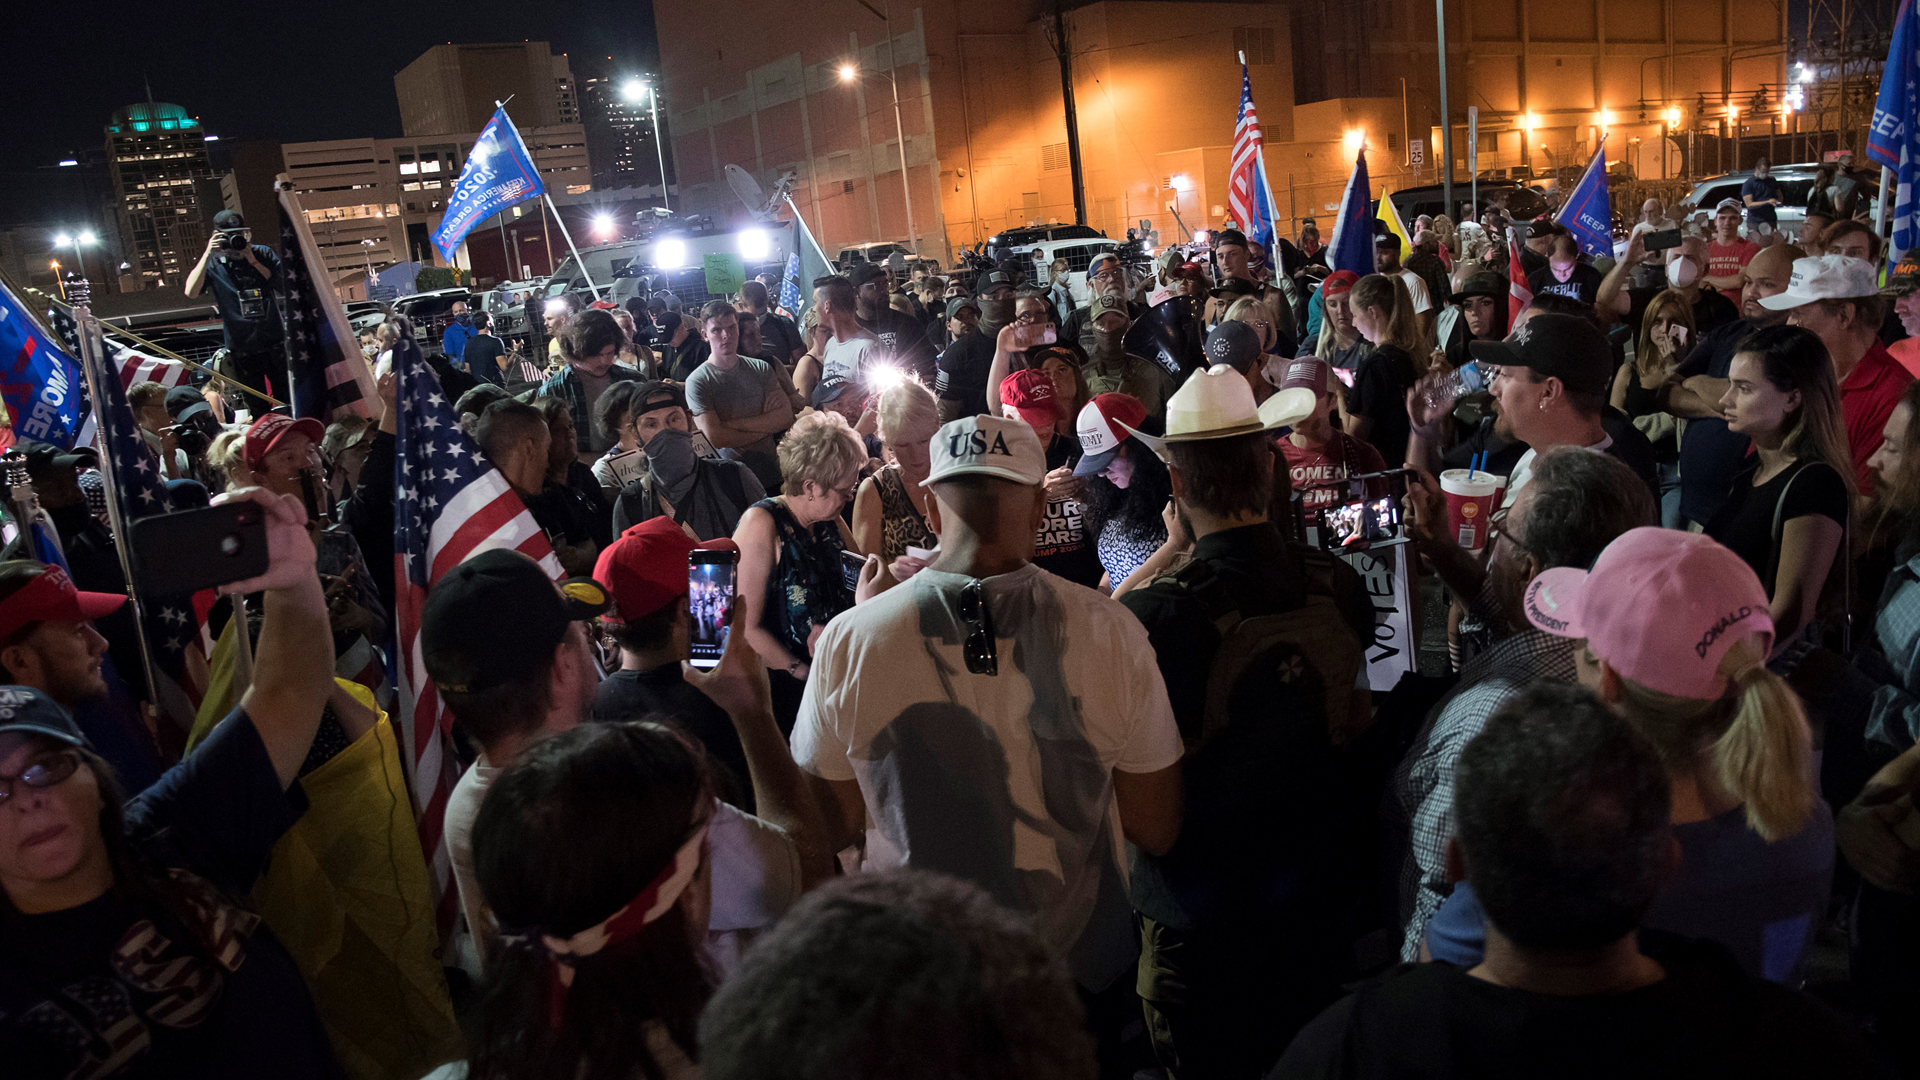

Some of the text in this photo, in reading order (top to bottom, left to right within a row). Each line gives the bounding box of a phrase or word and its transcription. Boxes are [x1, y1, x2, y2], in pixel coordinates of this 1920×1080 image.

[1411, 152, 1422, 163] 25
[1580, 212, 1605, 231] KEEP
[1156, 351, 1177, 373] PYLE
[823, 377, 845, 388] TRU
[949, 429, 1013, 458] USA
[1289, 466, 1345, 480] OMEN
[1046, 500, 1081, 518] UR
[1036, 515, 1082, 532] ORE
[1036, 530, 1083, 546] EARS
[1034, 548, 1057, 557] UMP
[1527, 603, 1570, 632] PRESIDENT
[1695, 605, 1752, 659] DONALD
